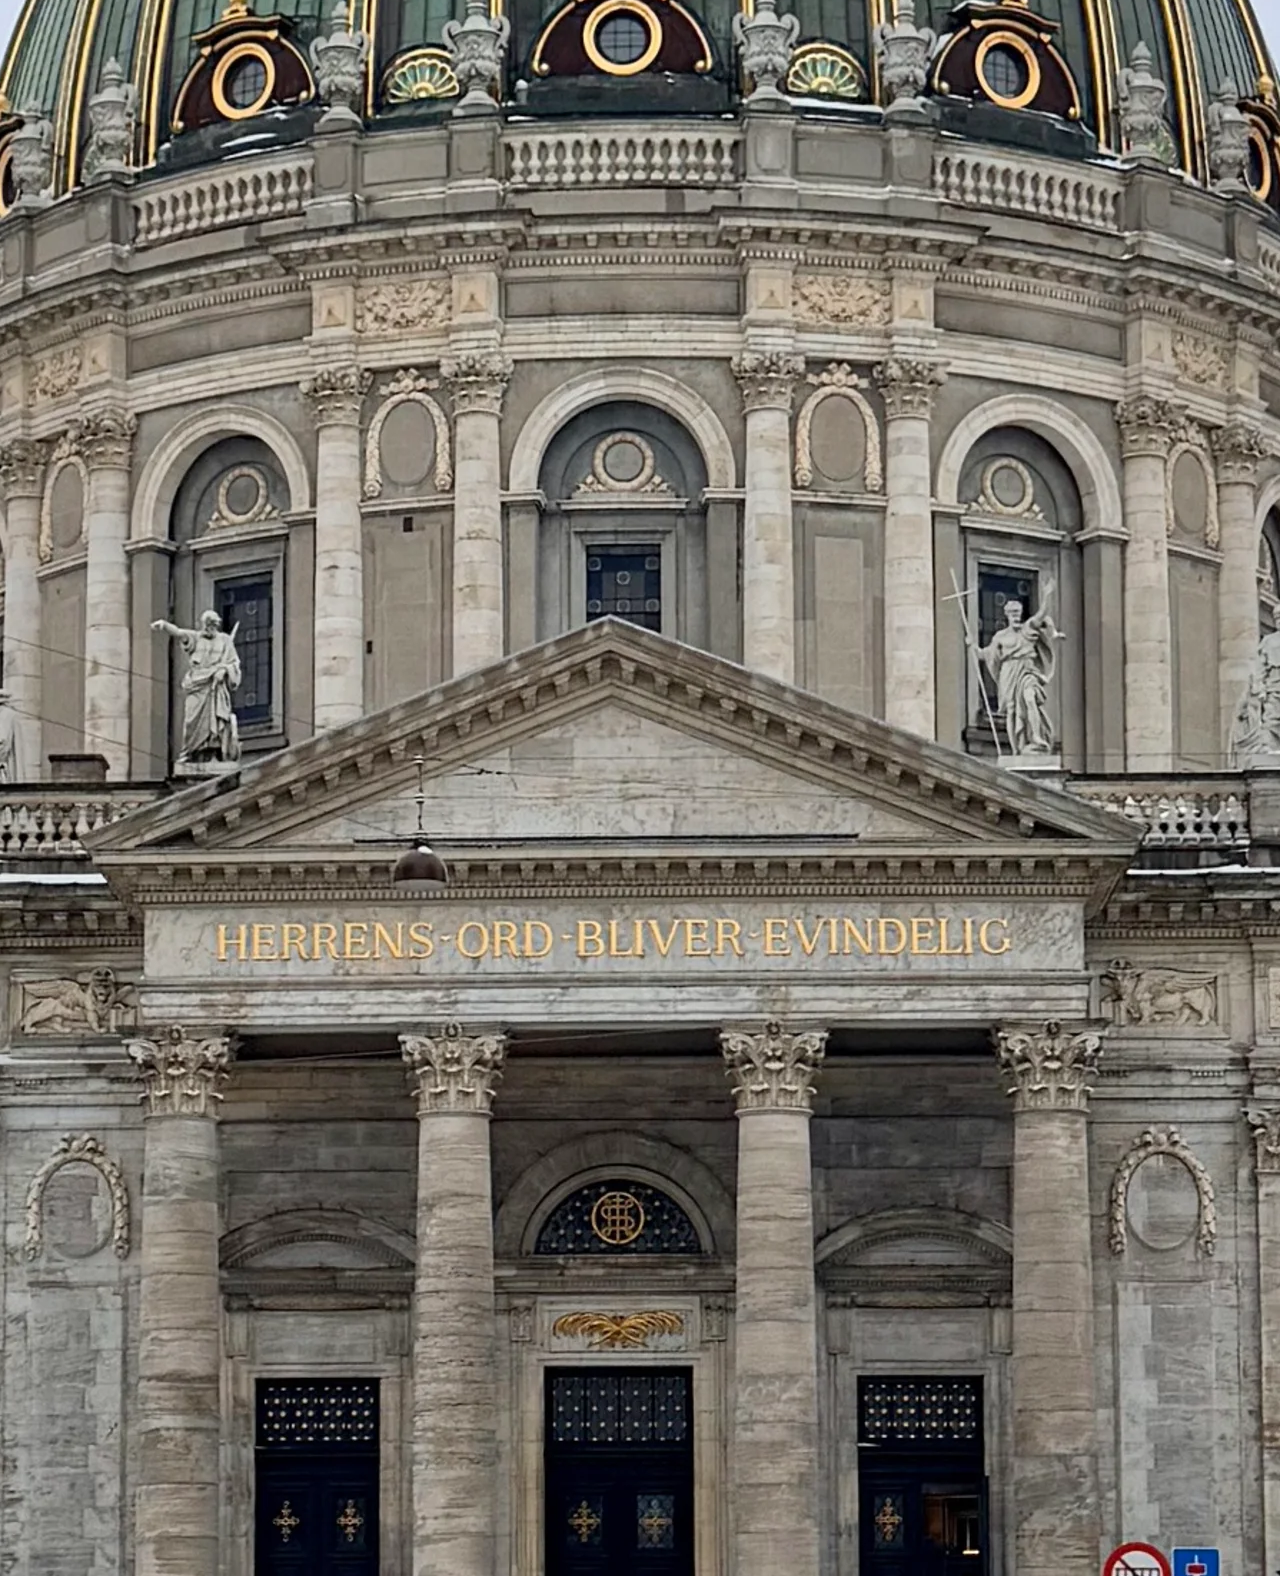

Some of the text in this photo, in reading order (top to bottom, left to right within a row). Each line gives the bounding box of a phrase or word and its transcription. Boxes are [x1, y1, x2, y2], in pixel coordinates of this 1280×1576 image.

[216, 916, 1013, 962] HERRENS ORD BLIVER EVINDELIG
